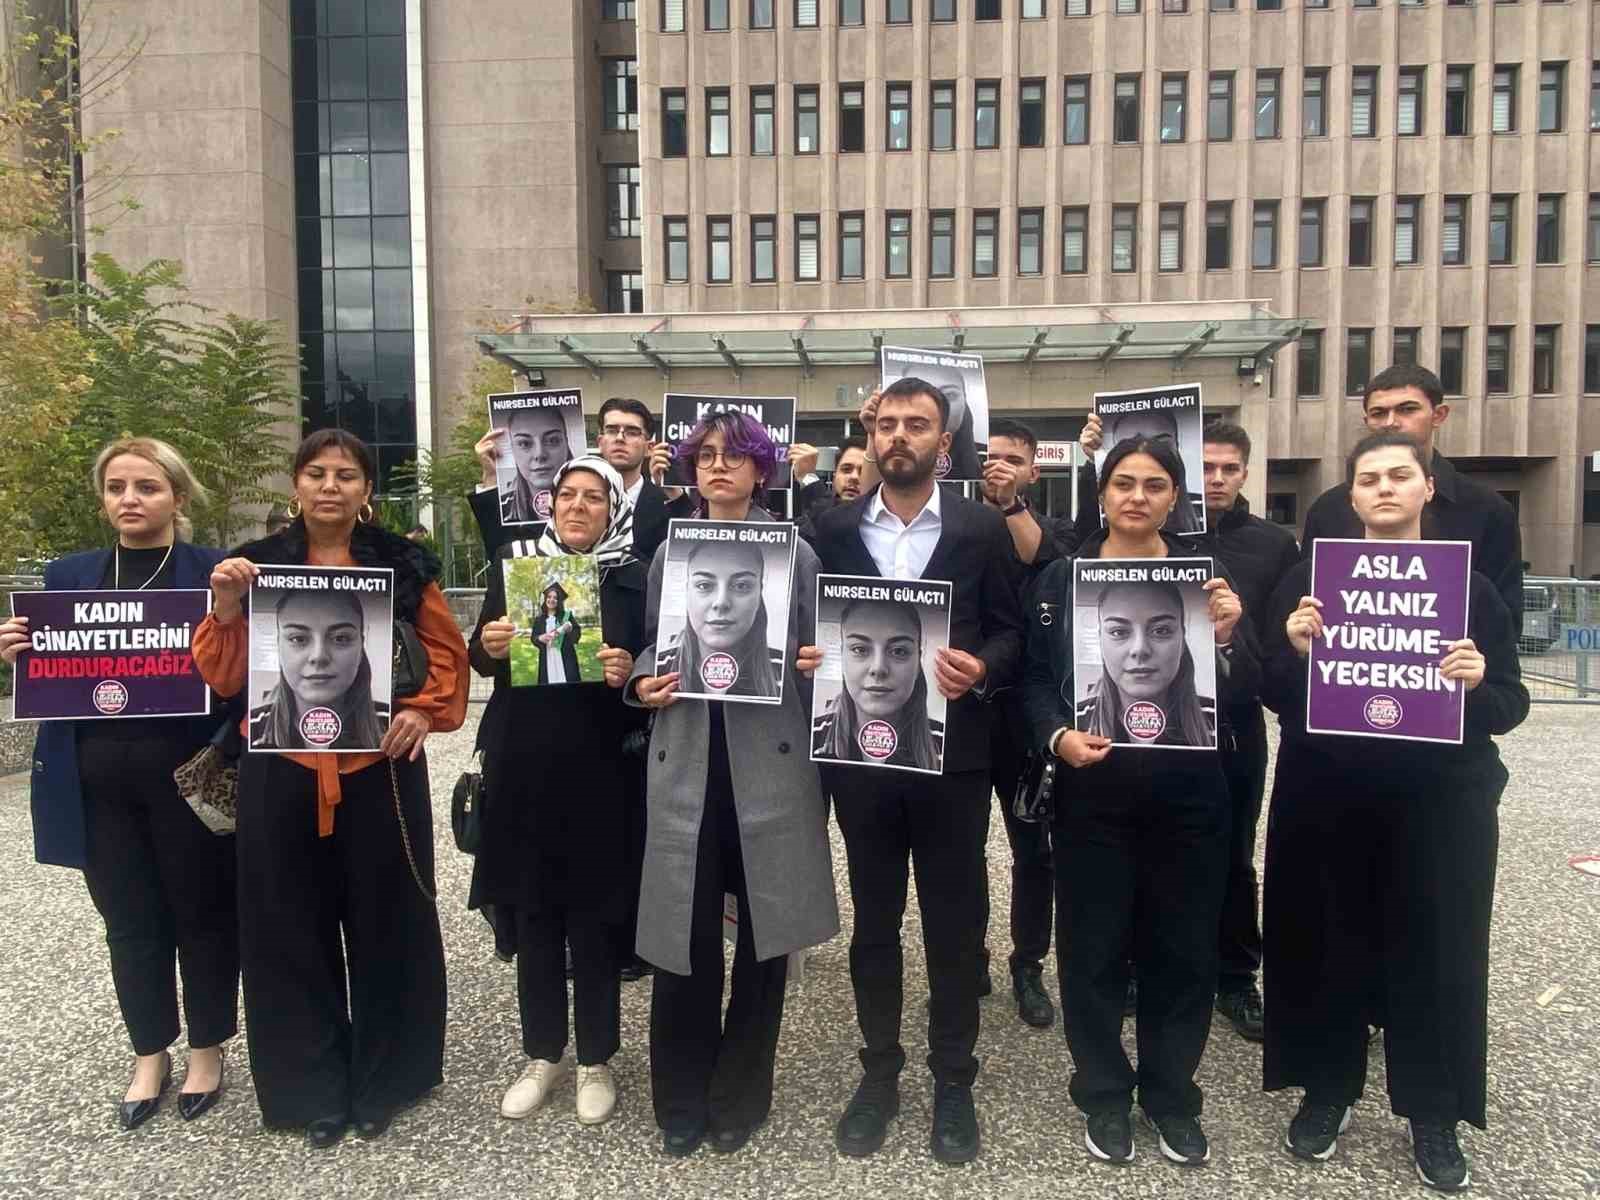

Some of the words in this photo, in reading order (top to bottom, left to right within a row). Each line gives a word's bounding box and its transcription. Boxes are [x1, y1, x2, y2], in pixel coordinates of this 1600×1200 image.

[493, 397, 541, 410] NURSELEN
[1099, 400, 1151, 414] NURSELEN
[674, 528, 736, 541] NURSELEN
[1080, 568, 1147, 582] NURSELEN
[1151, 566, 1207, 582] GÜLAÇTI
[1351, 554, 1428, 581] ASLA
[257, 575, 329, 590] NURSELEN
[332, 575, 387, 592] GÜLAÇTI
[823, 584, 890, 600] NURSELEN
[893, 587, 945, 605] GÜLAÇTI
[1340, 590, 1439, 618] YALNIZ
[74, 602, 143, 624] KADIN
[31, 622, 190, 651] CİNAYETLERİNİ
[28, 650, 193, 679] DURDURACAĞIZ
[1317, 660, 1457, 692] YECEKSİN
